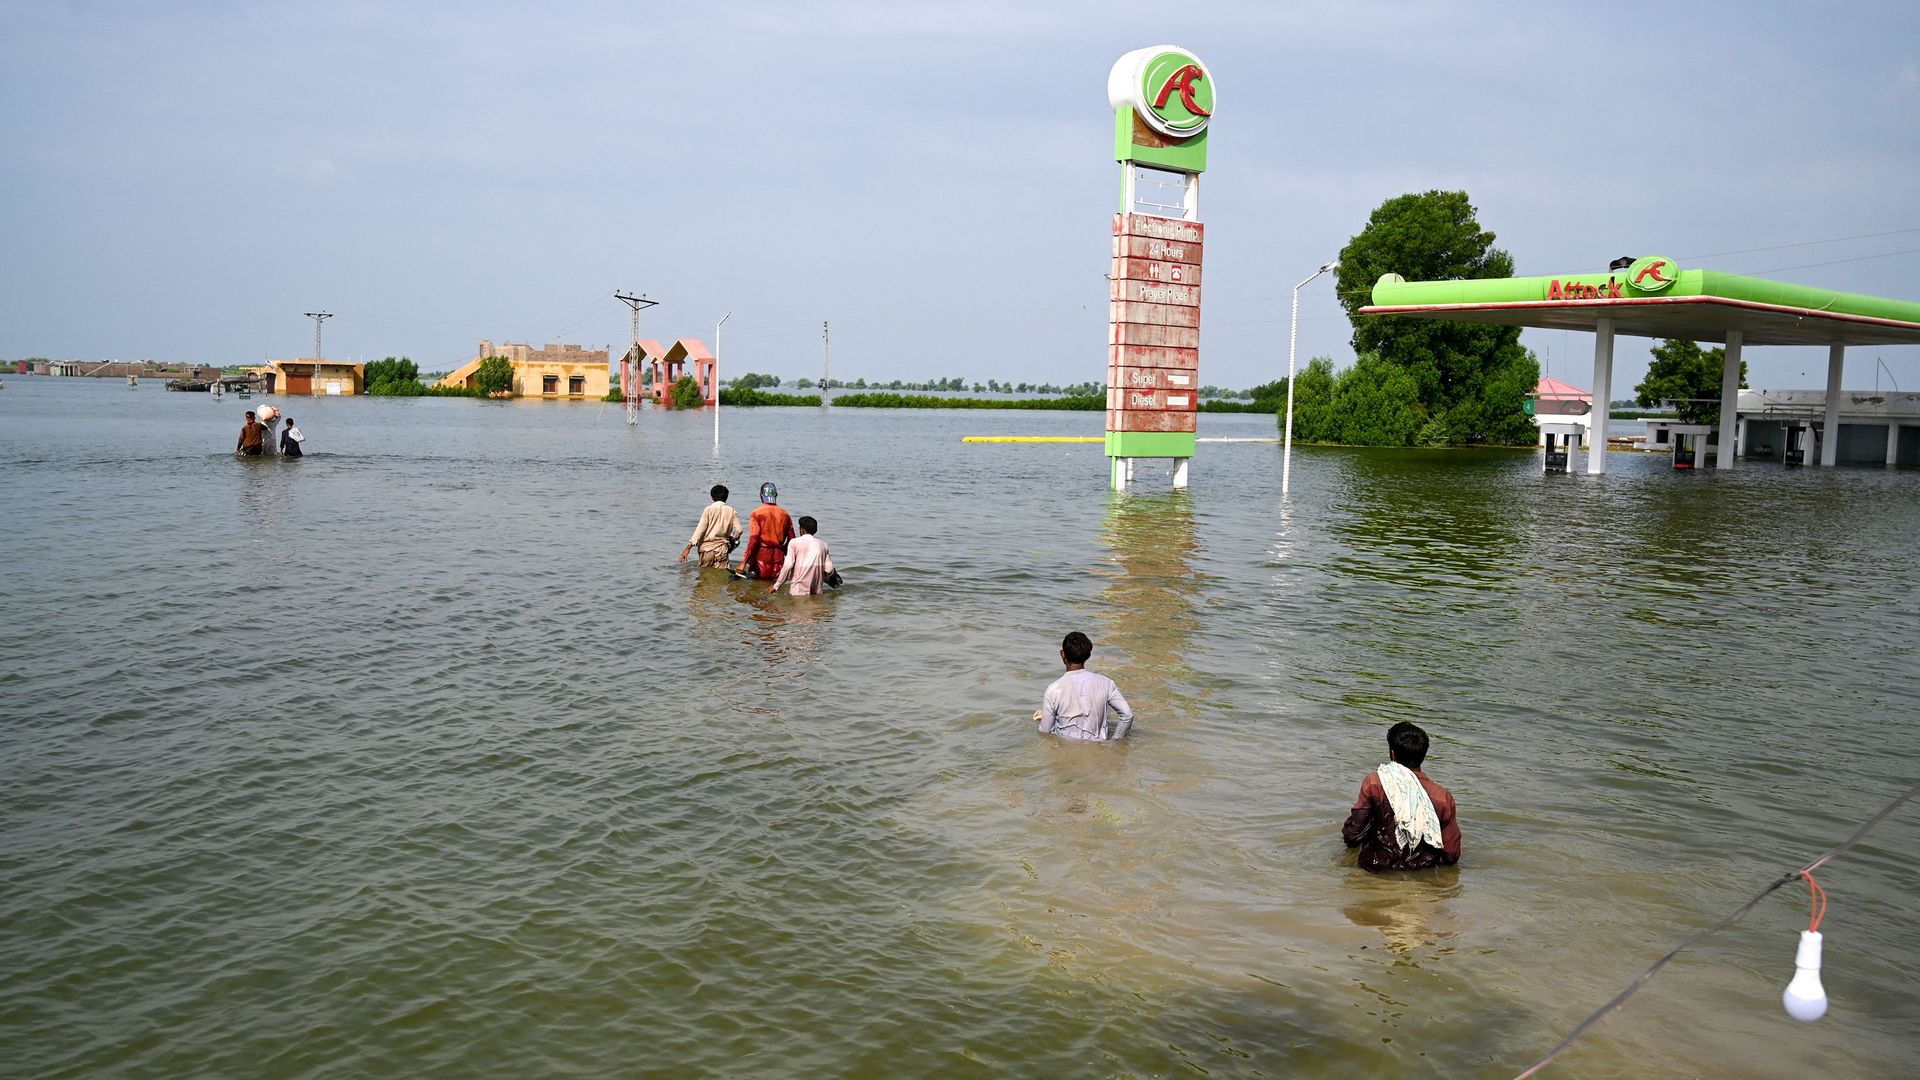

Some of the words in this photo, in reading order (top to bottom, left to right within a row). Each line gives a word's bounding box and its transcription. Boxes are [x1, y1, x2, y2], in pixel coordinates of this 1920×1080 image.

[1136, 220, 1174, 235] Electronic
[1176, 226, 1198, 241] Pump
[1149, 243, 1159, 255] 24
[1160, 245, 1184, 258] Hours
[1140, 286, 1166, 300] Prayer
[1167, 289, 1188, 301] Place
[1547, 276, 1624, 300] Attock
[1132, 372, 1157, 385] Super
[1131, 394, 1156, 406] Diesel
